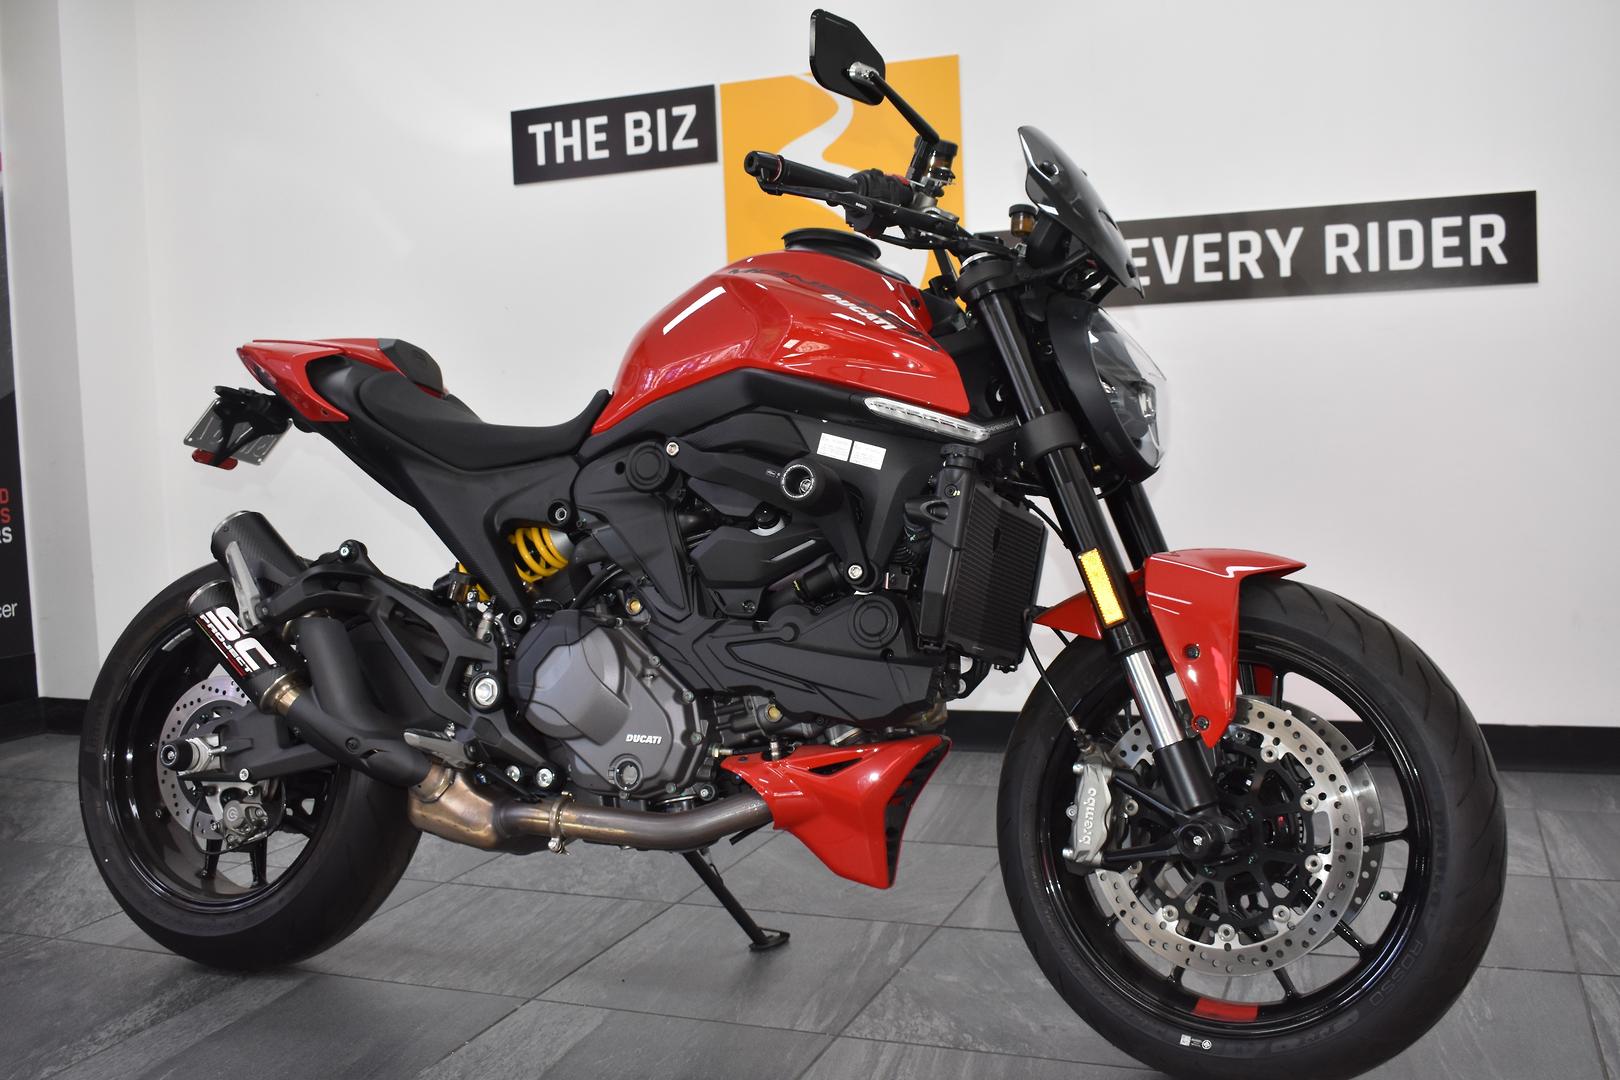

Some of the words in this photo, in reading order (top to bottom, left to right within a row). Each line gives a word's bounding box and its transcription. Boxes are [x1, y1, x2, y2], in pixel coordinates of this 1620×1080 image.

[527, 116, 610, 166] THE
[624, 104, 699, 156] BIZ
[1123, 227, 1304, 286] EVERY
[1324, 213, 1508, 275] RIDER
[821, 294, 898, 330] DUCATI
[0, 602, 18, 618] er
[625, 733, 663, 745] DUCATI
[1079, 787, 1097, 845] brembo
